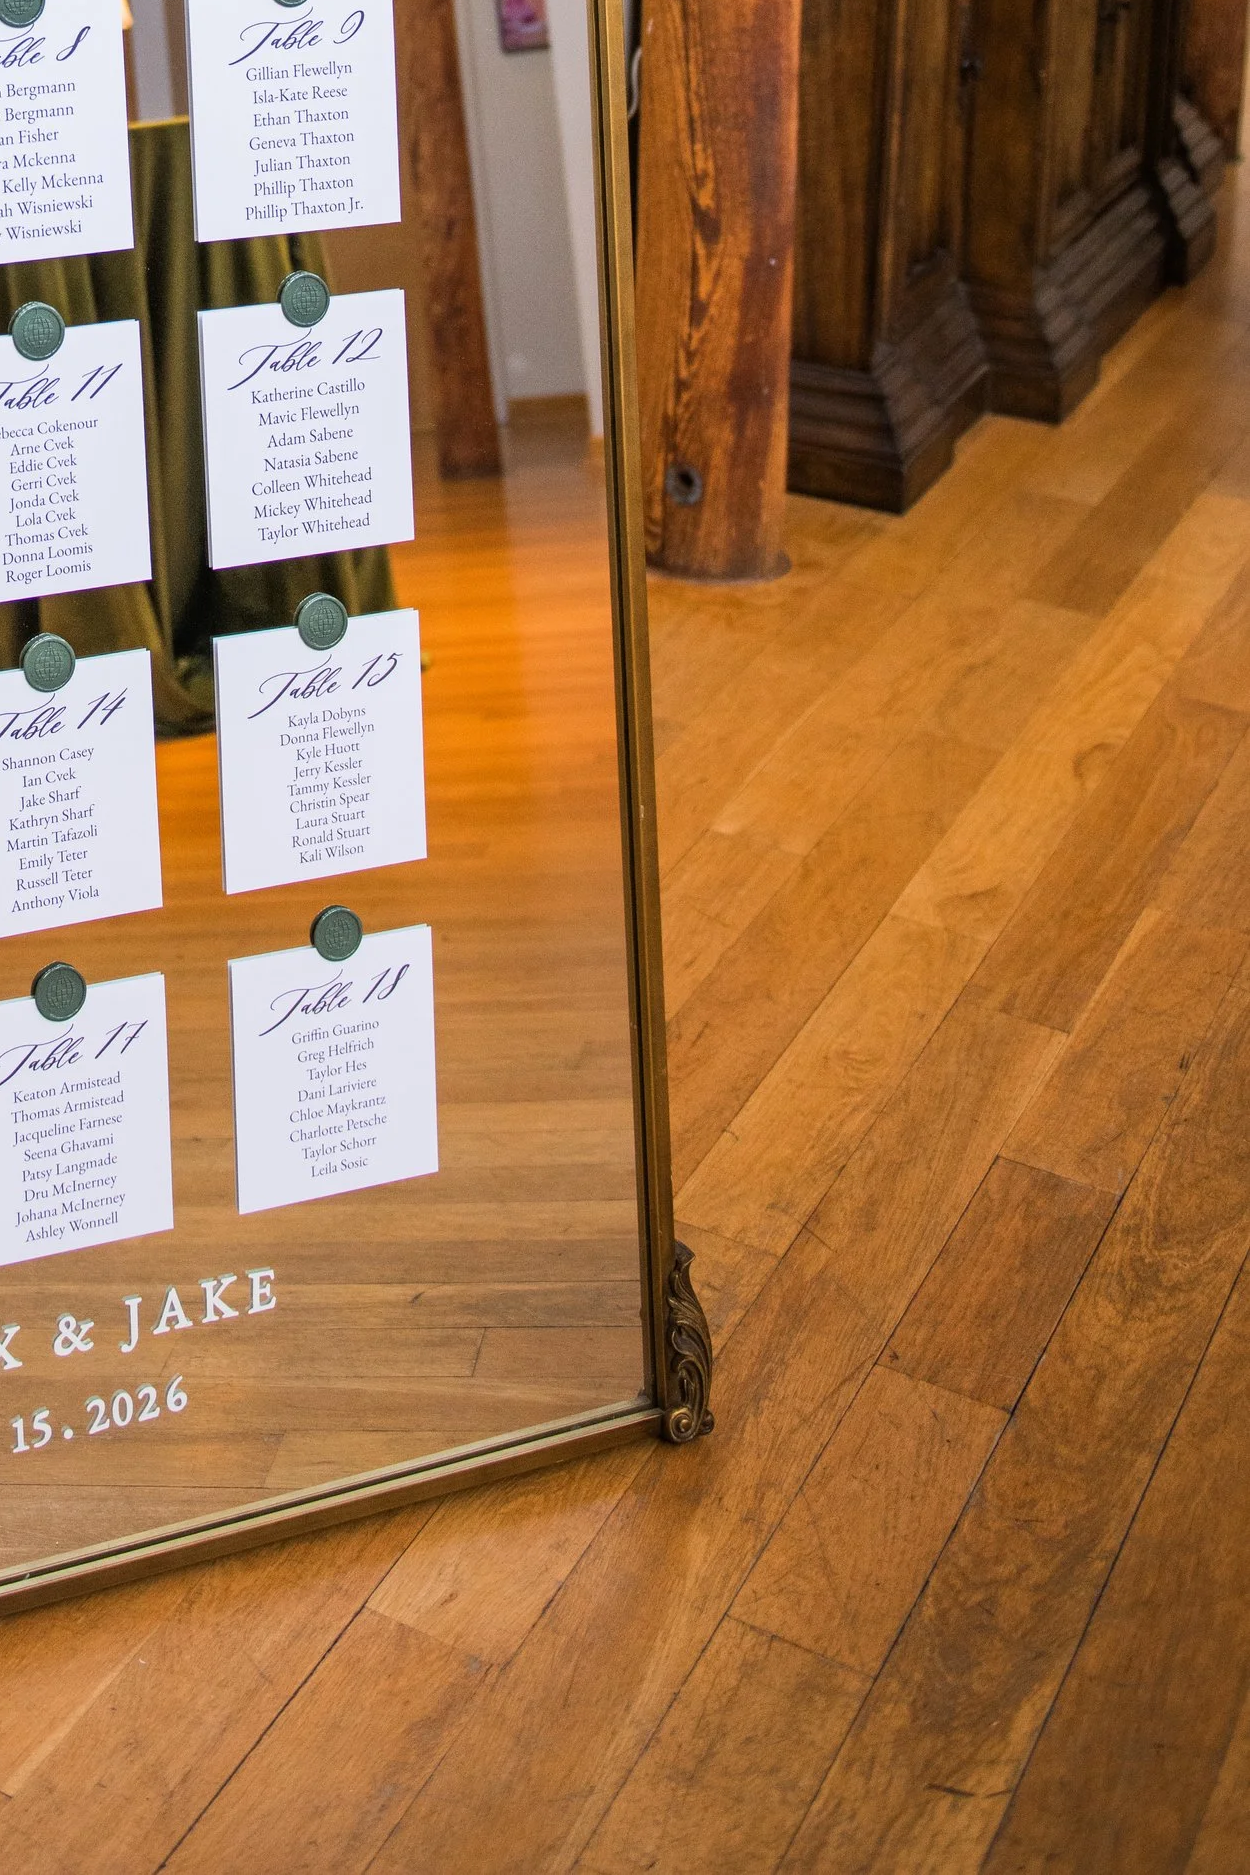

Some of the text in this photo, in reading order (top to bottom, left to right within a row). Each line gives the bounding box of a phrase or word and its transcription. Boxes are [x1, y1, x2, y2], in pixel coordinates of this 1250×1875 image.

[55, 25, 92, 62] 8
[227, 6, 365, 66] Table 9
[245, 60, 353, 82] Gillian Flewellyn
[253, 85, 348, 105] Isla-Kate Reese
[4, 105, 74, 125] Bergmann
[13, 152, 76, 169] Mckenna
[253, 154, 351, 178] Julian Thaxton
[16, 194, 93, 216] Wisniewski
[226, 327, 384, 391] Table 12
[70, 362, 124, 402] 11
[251, 377, 366, 405] Katherine Castillo
[36, 419, 99, 435] Cokenour
[266, 426, 354, 449] Adam Sabene
[253, 489, 373, 520] Mickey Whitehead
[4, 523, 89, 547] Thomas Cvek
[5, 559, 92, 583] Roger Loomis
[246, 652, 404, 720] Table 15
[76, 687, 128, 730] 14
[288, 707, 366, 730] Kayla Dobyns
[1, 747, 95, 772] Shannon Casey
[293, 756, 363, 782] Jerry Kessler
[9, 803, 96, 832] Kathryn Sharf
[292, 826, 371, 849] Ronald Stuart
[19, 849, 89, 871] Emily Teter
[258, 963, 411, 1037] Table 18
[94, 1019, 149, 1060] 17
[297, 1037, 375, 1064] Greg Helfrich
[10, 1089, 124, 1124] Thomas Armistead
[289, 1113, 387, 1143] Charlotte Petsche
[22, 1152, 118, 1183] Patsy Langmade
[25, 1210, 118, 1243] Ashley Wonnell
[53, 1312, 95, 1356] &
[119, 1266, 277, 1354] JAKE
